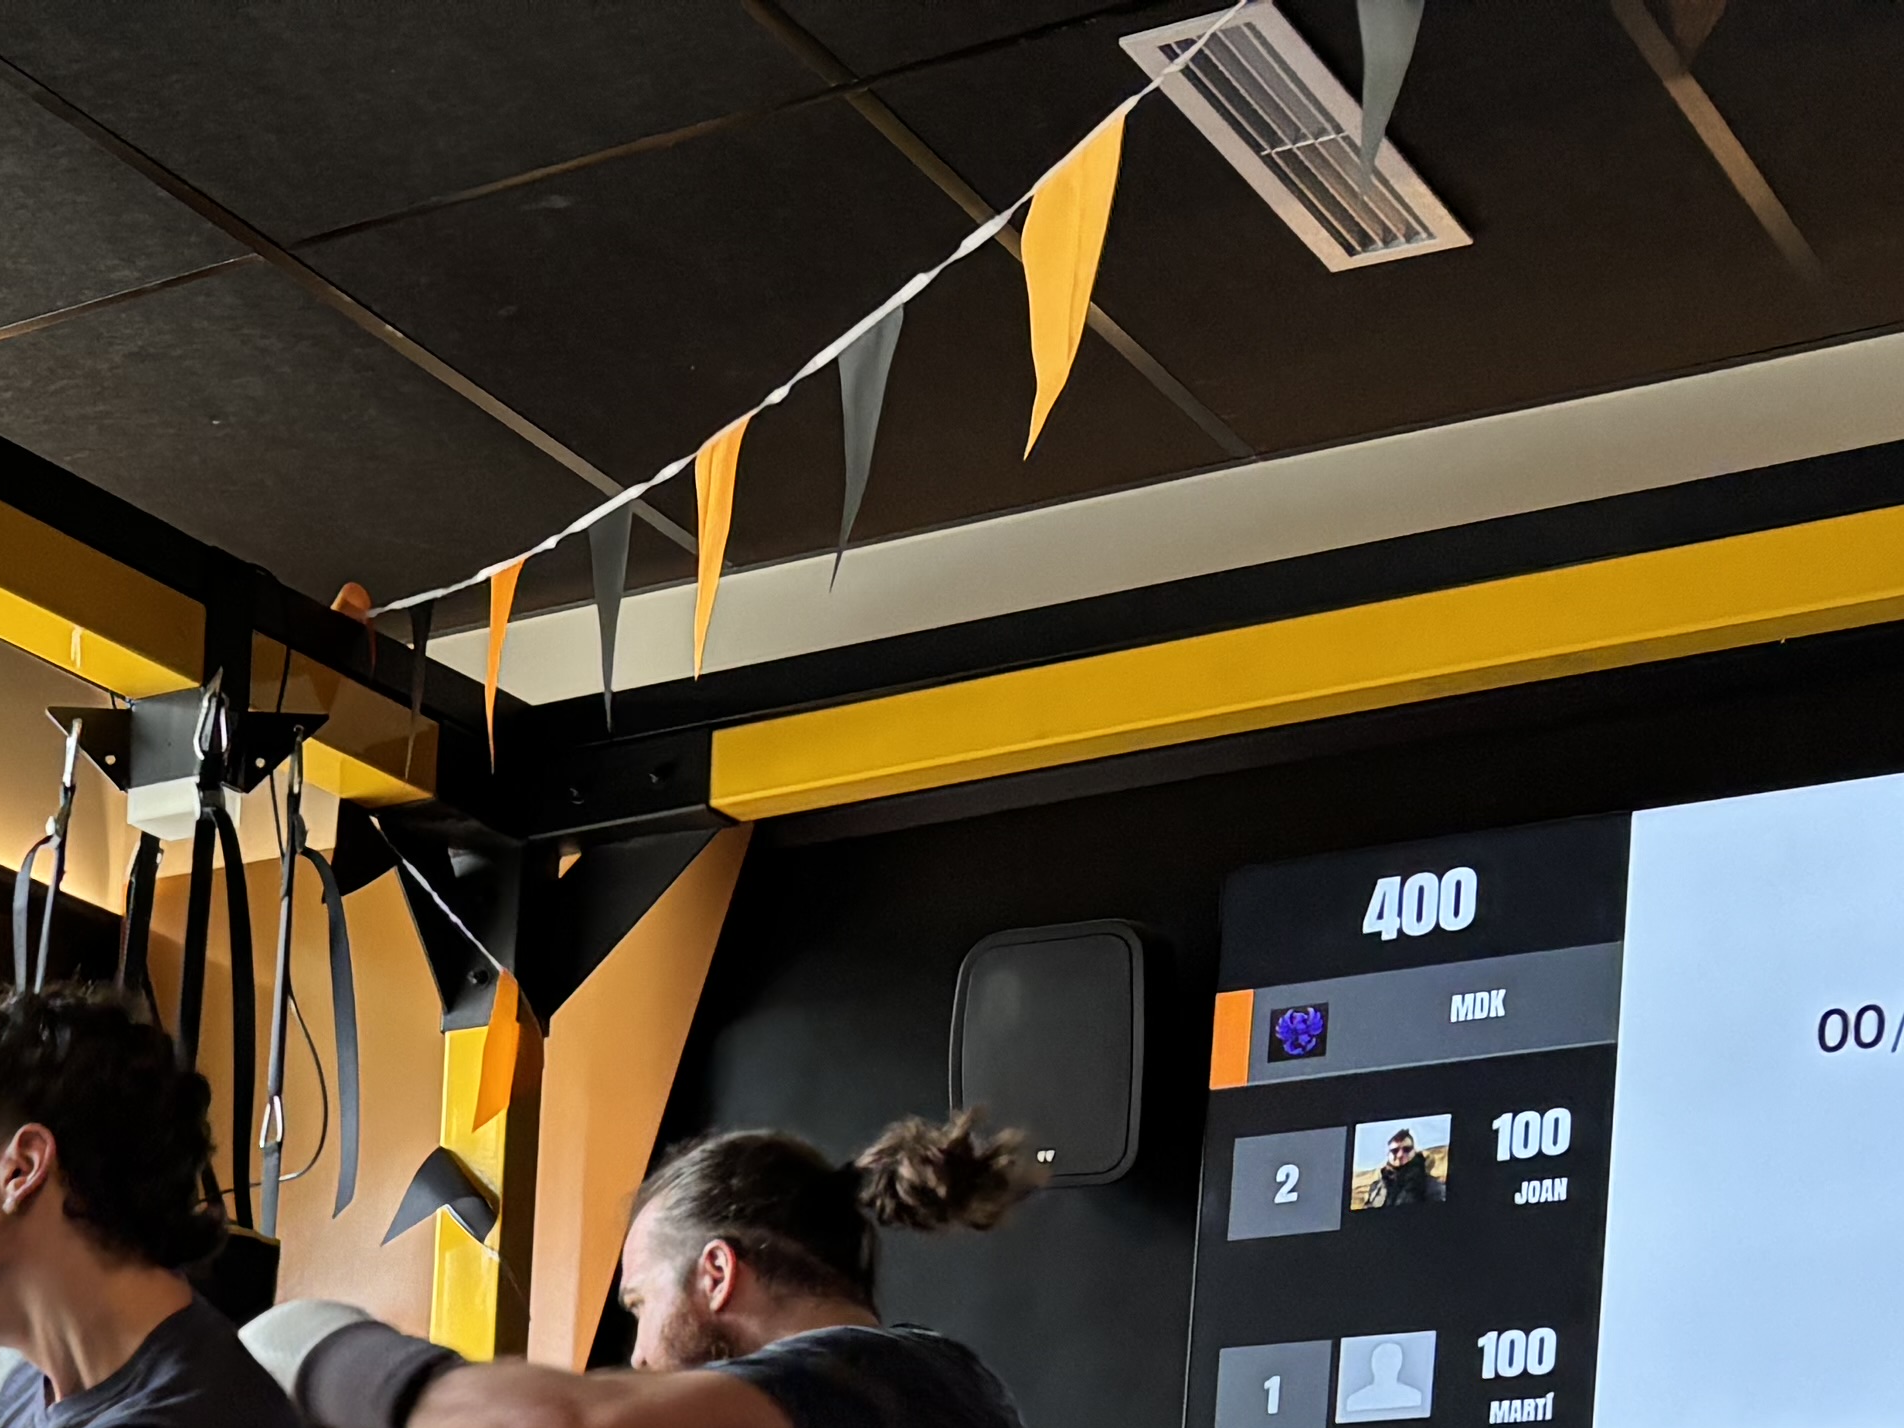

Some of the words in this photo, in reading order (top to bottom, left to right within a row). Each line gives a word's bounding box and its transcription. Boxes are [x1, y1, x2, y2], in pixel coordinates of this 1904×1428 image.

[1362, 866, 1478, 941] 400
[1450, 988, 1507, 1023] MDK
[1491, 1107, 1572, 1162] 100
[1274, 1164, 1300, 1204] 2
[1514, 1177, 1569, 1205] JOAN
[1477, 1327, 1557, 1380] 100
[1263, 1375, 1281, 1415] 1
[1488, 1391, 1555, 1425] MARTÍ
